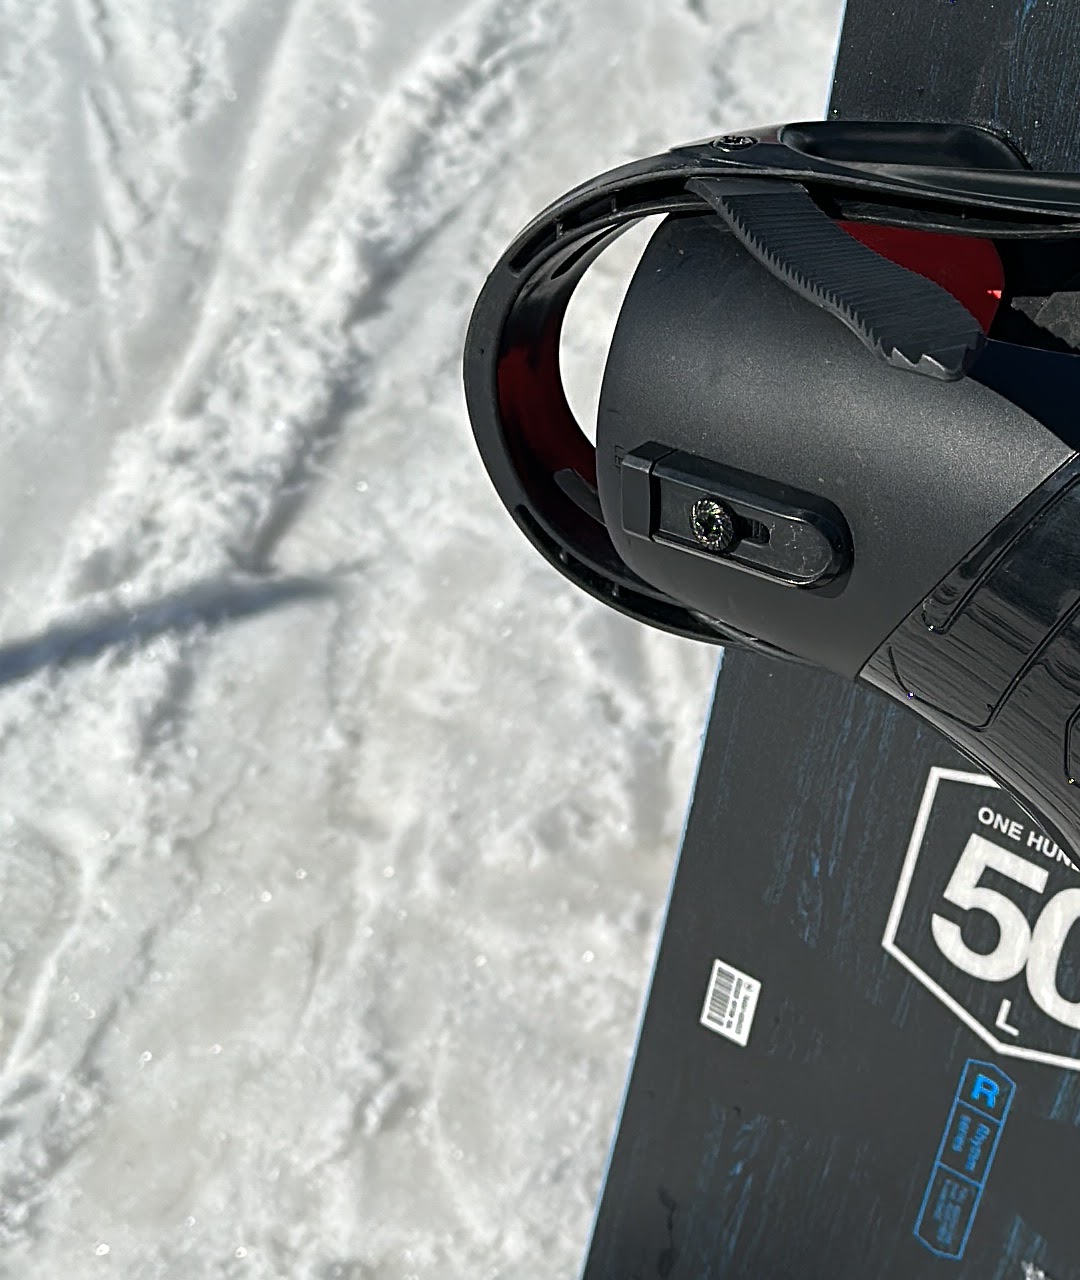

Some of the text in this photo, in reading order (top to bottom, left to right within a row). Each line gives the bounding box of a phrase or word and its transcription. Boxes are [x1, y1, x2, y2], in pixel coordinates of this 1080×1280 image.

[978, 806, 1080, 873] ONE HUN
[995, 998, 1020, 1036] L
[971, 1073, 1000, 1109] R
